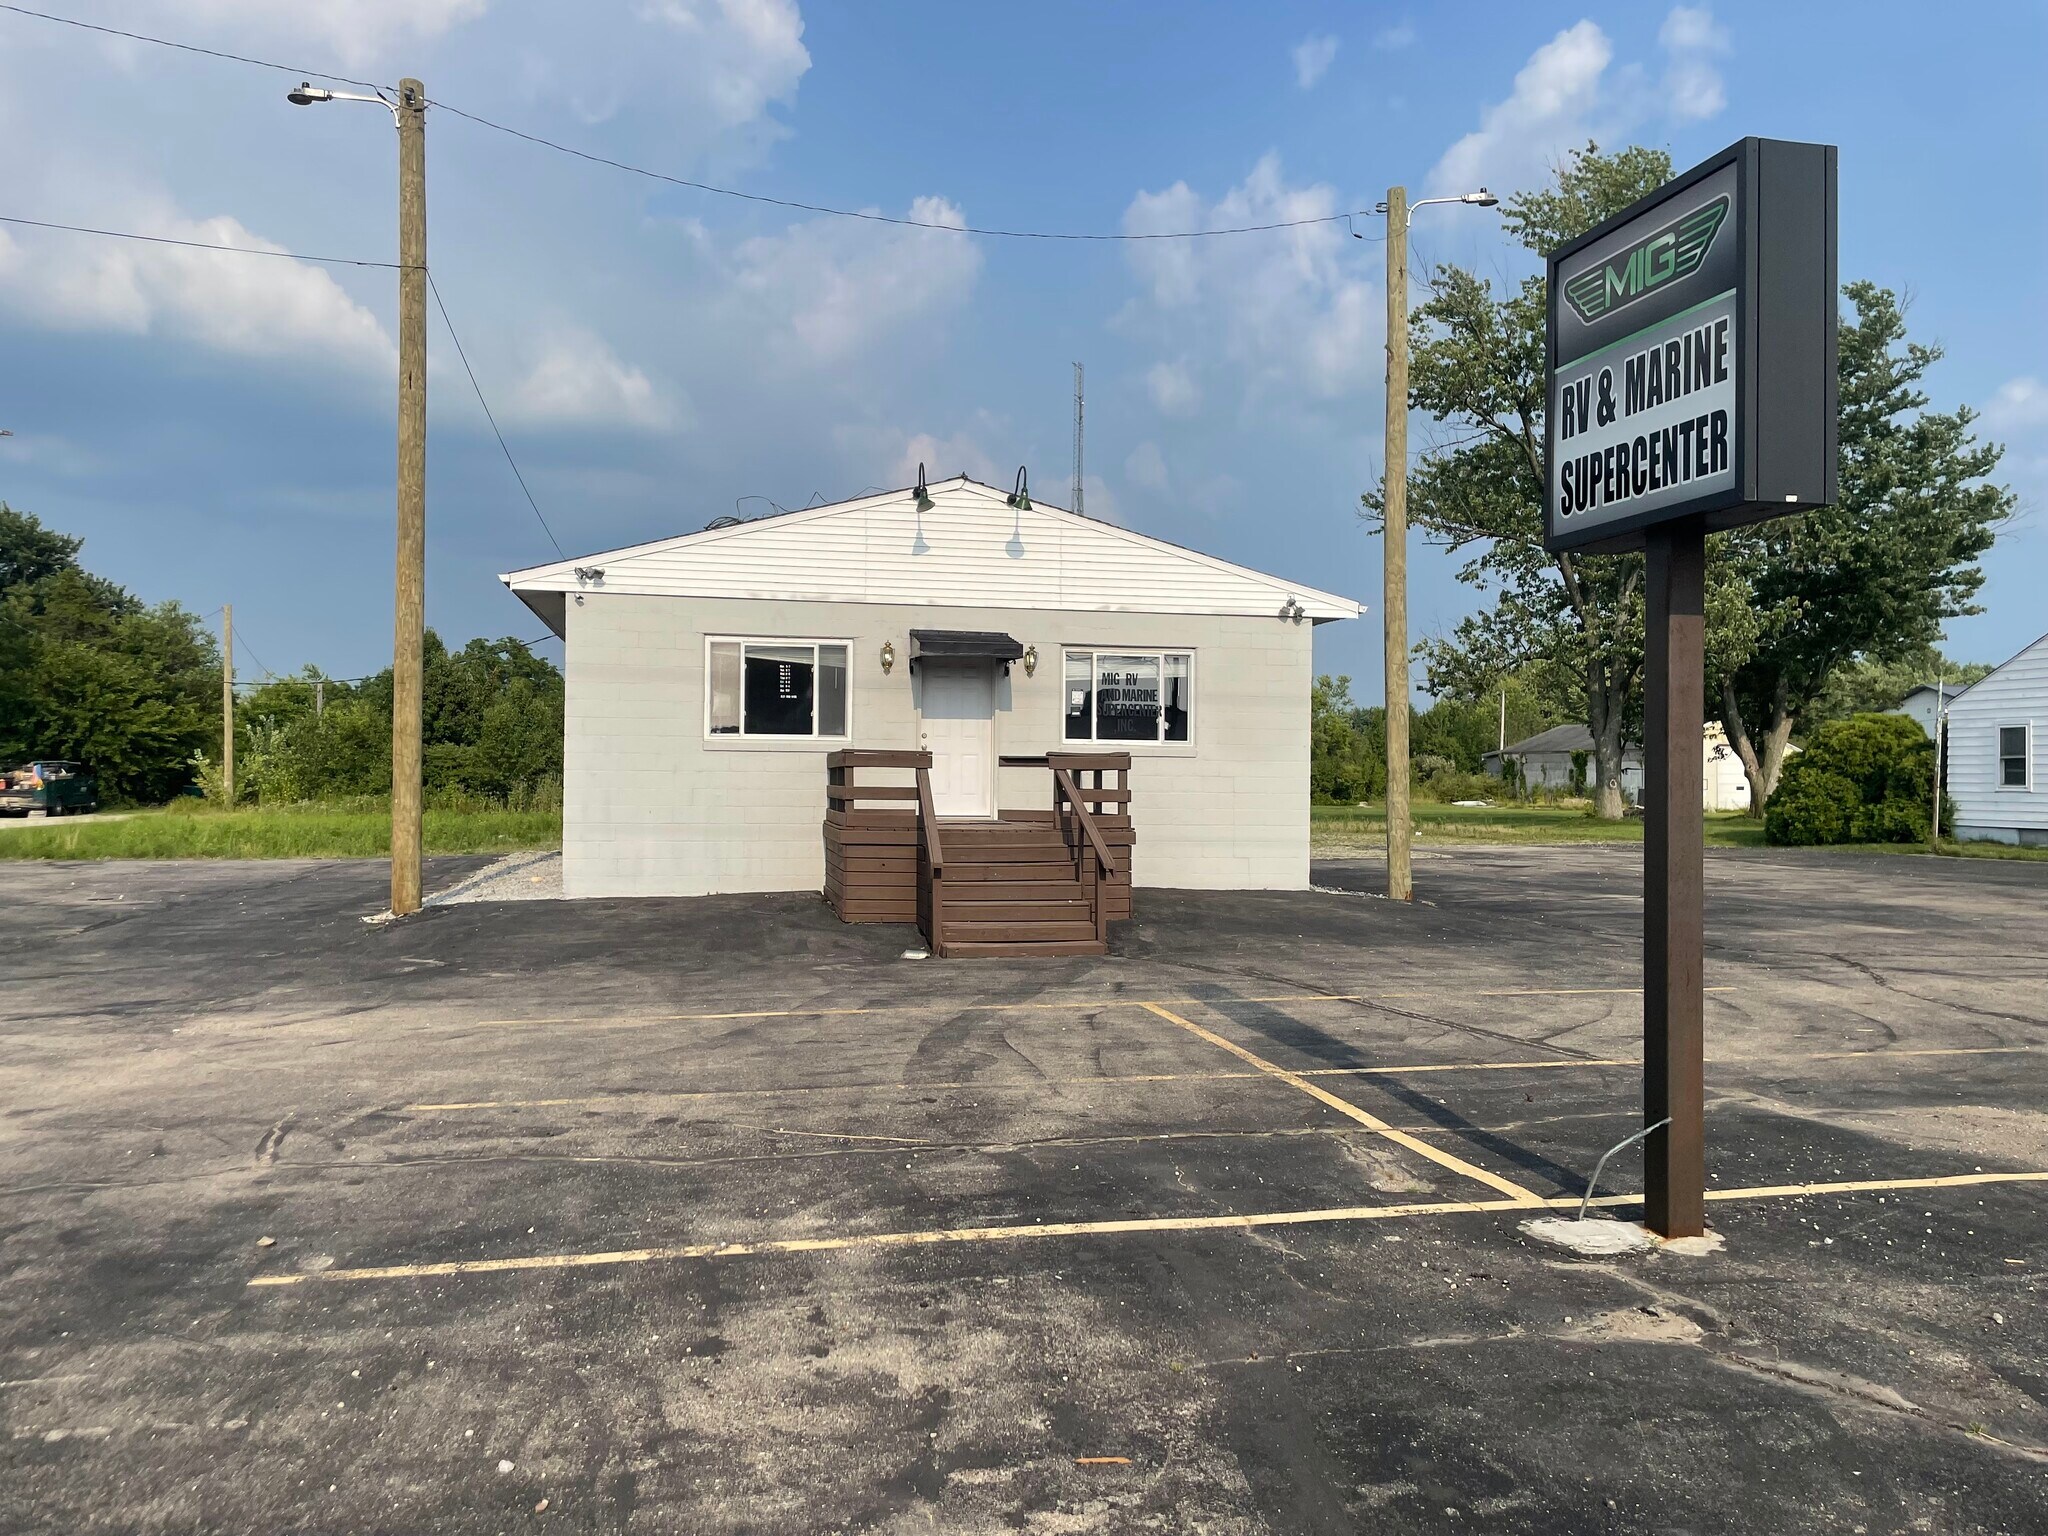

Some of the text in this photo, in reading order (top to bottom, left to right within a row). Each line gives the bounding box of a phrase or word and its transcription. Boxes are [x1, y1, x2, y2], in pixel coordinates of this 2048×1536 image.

[1604, 231, 1676, 308] MIG
[1561, 318, 1729, 441] RV & MARINE
[1560, 409, 1729, 517] SUPERCENTER
[1101, 672, 1139, 686] MIG RV
[1101, 688, 1158, 702] AND MARINE
[1097, 703, 1162, 717] SUPERCENTER
